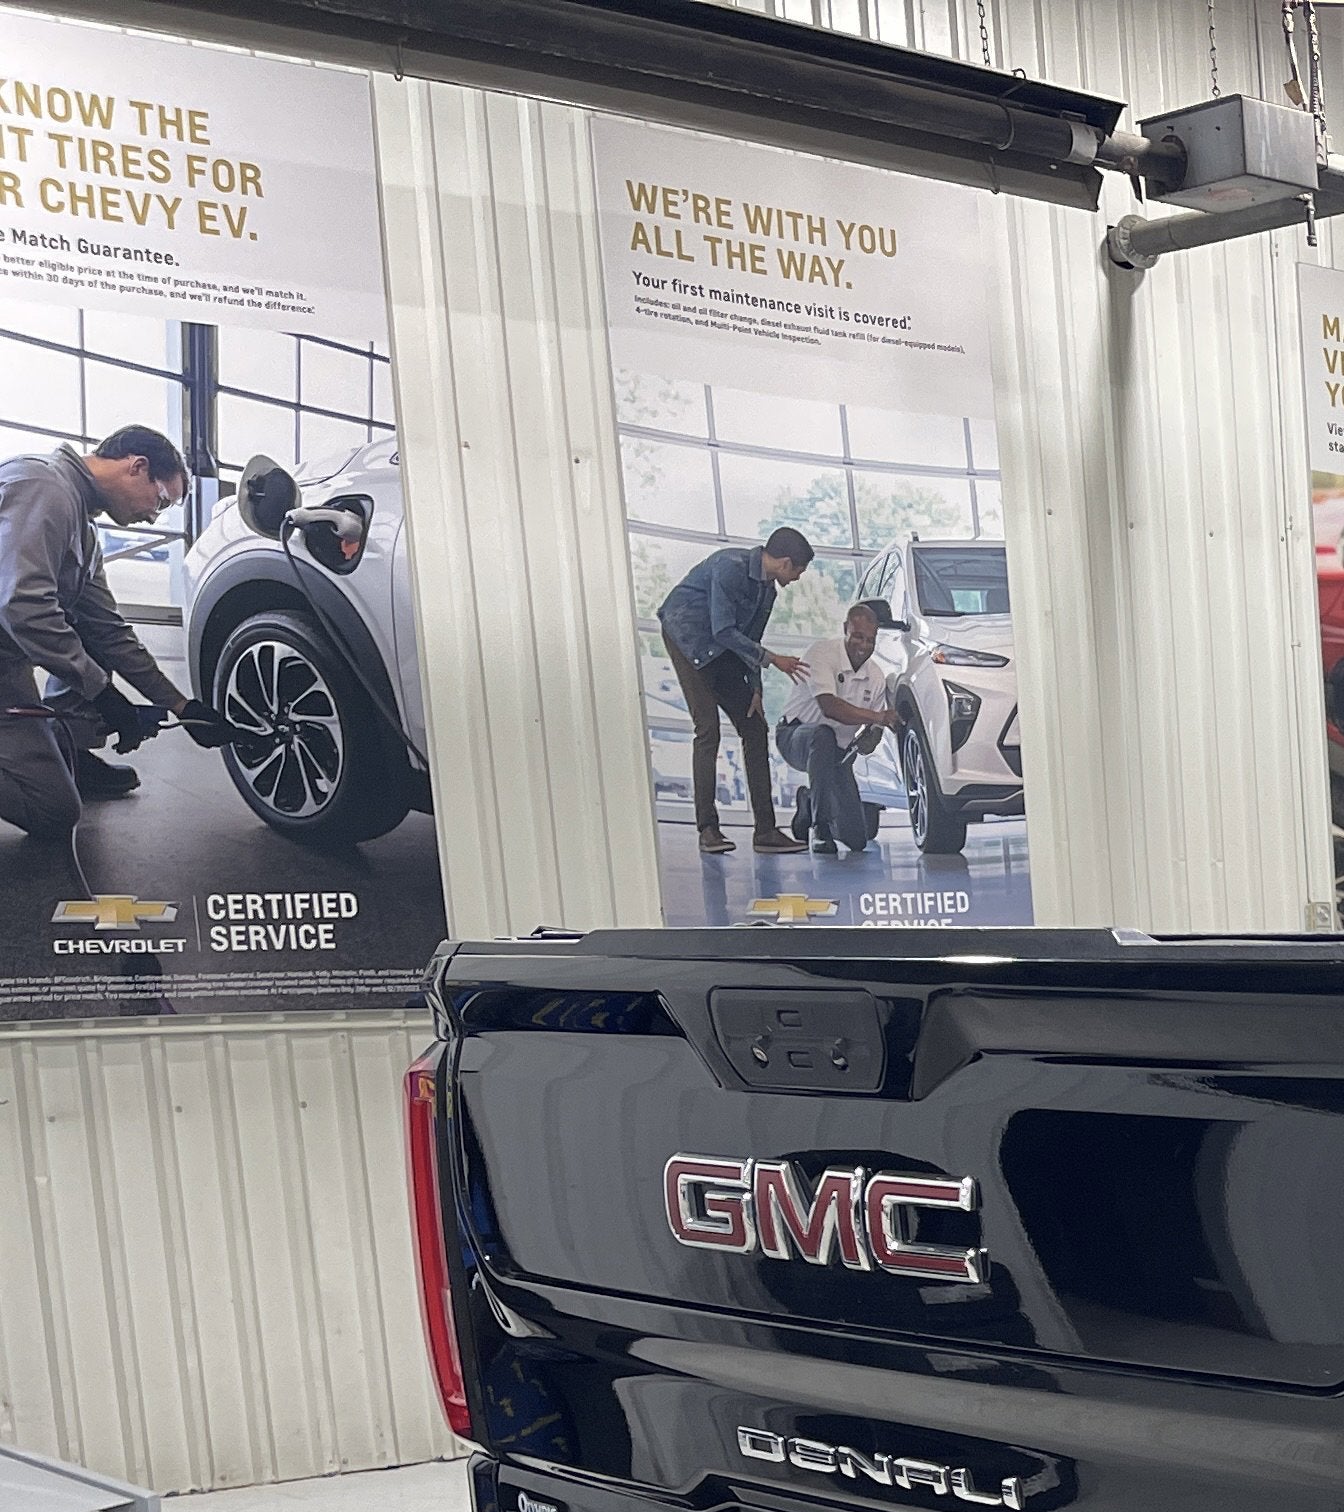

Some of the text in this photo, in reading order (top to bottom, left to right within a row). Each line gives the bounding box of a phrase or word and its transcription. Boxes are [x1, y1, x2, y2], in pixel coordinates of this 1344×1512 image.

[129, 100, 210, 146] THE
[48, 131, 171, 184] TIRES
[186, 153, 264, 198] FOR
[39, 177, 182, 230] CHEVY
[198, 200, 258, 241] EV.
[625, 179, 897, 258] WE'RE WITH YOU
[10, 227, 70, 252] Match
[77, 238, 180, 267] Guarantee.
[630, 221, 853, 290] ALL THE WAY.
[62, 276, 85, 288] days
[100, 281, 116, 291] the
[170, 291, 186, 300] and
[247, 299, 262, 309] the
[77, 266, 102, 276] price
[118, 270, 134, 281] the
[137, 273, 158, 284] time
[161, 276, 171, 285] of
[222, 285, 239, 294] and
[266, 288, 294, 300] match
[632, 270, 668, 291] Your
[671, 279, 705, 298] first
[709, 288, 801, 314] maintenance
[804, 303, 835, 320] visit
[838, 307, 850, 322] is
[207, 892, 358, 920] CERTIFIED
[859, 891, 969, 915] CERTIFIED
[53, 938, 187, 955] CHEVROLET
[210, 924, 336, 952] SERVICE
[664, 1152, 990, 1285] GMC
[736, 1424, 1025, 1510] DENALI
